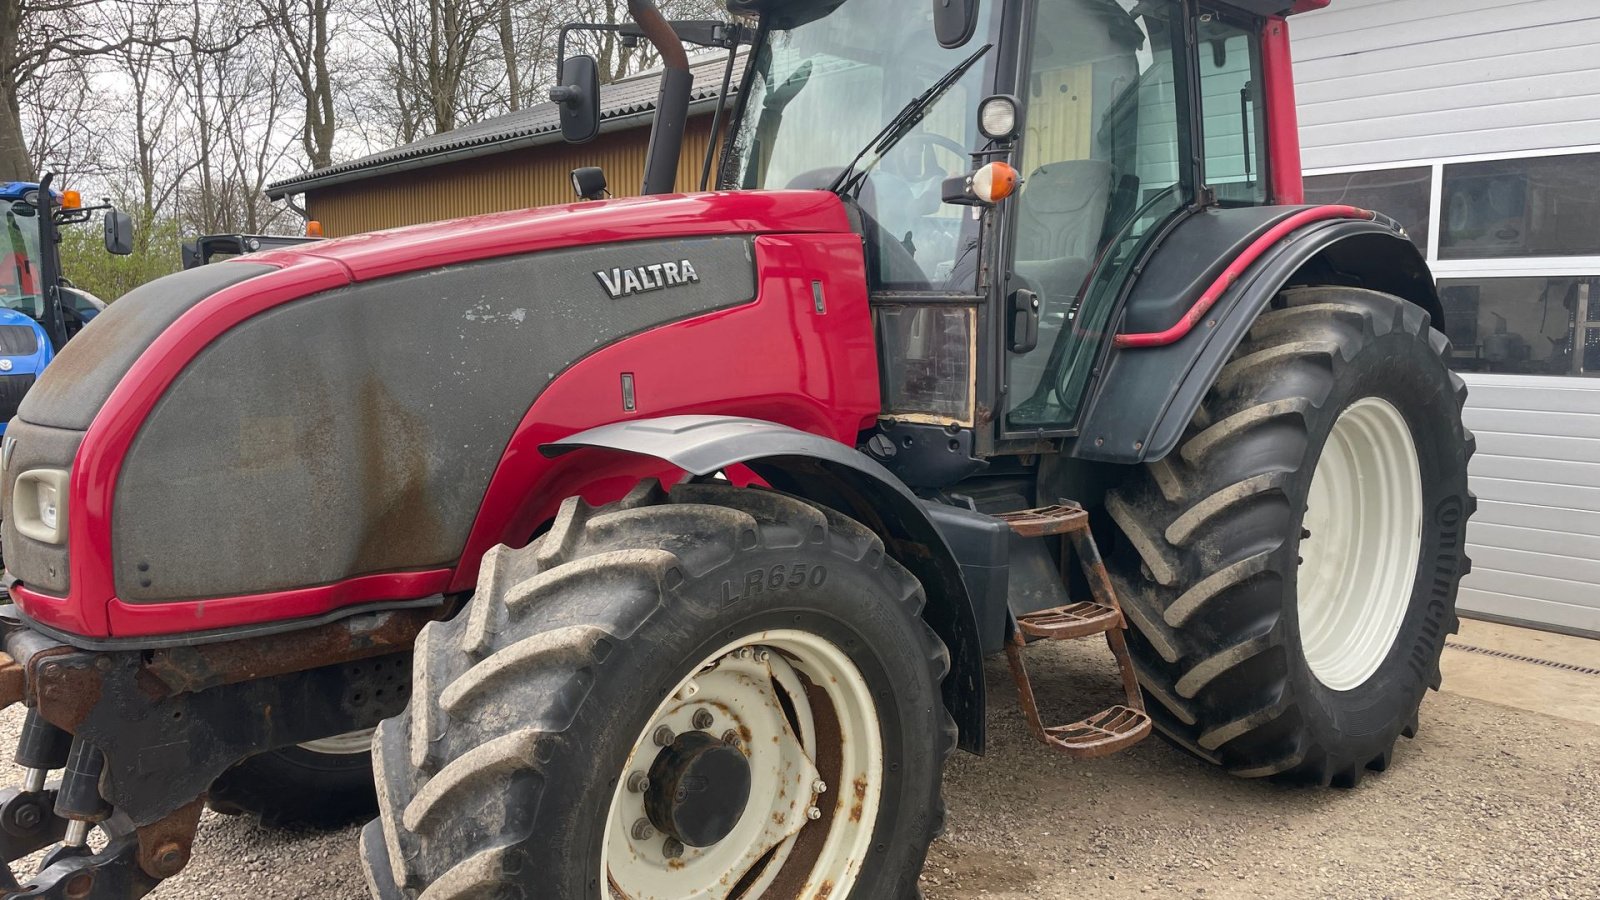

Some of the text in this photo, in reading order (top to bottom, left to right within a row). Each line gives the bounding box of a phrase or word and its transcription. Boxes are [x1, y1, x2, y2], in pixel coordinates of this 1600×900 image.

[595, 259, 699, 298] VALTRA
[721, 563, 828, 610] LR650
[1407, 494, 1463, 682] Continental
